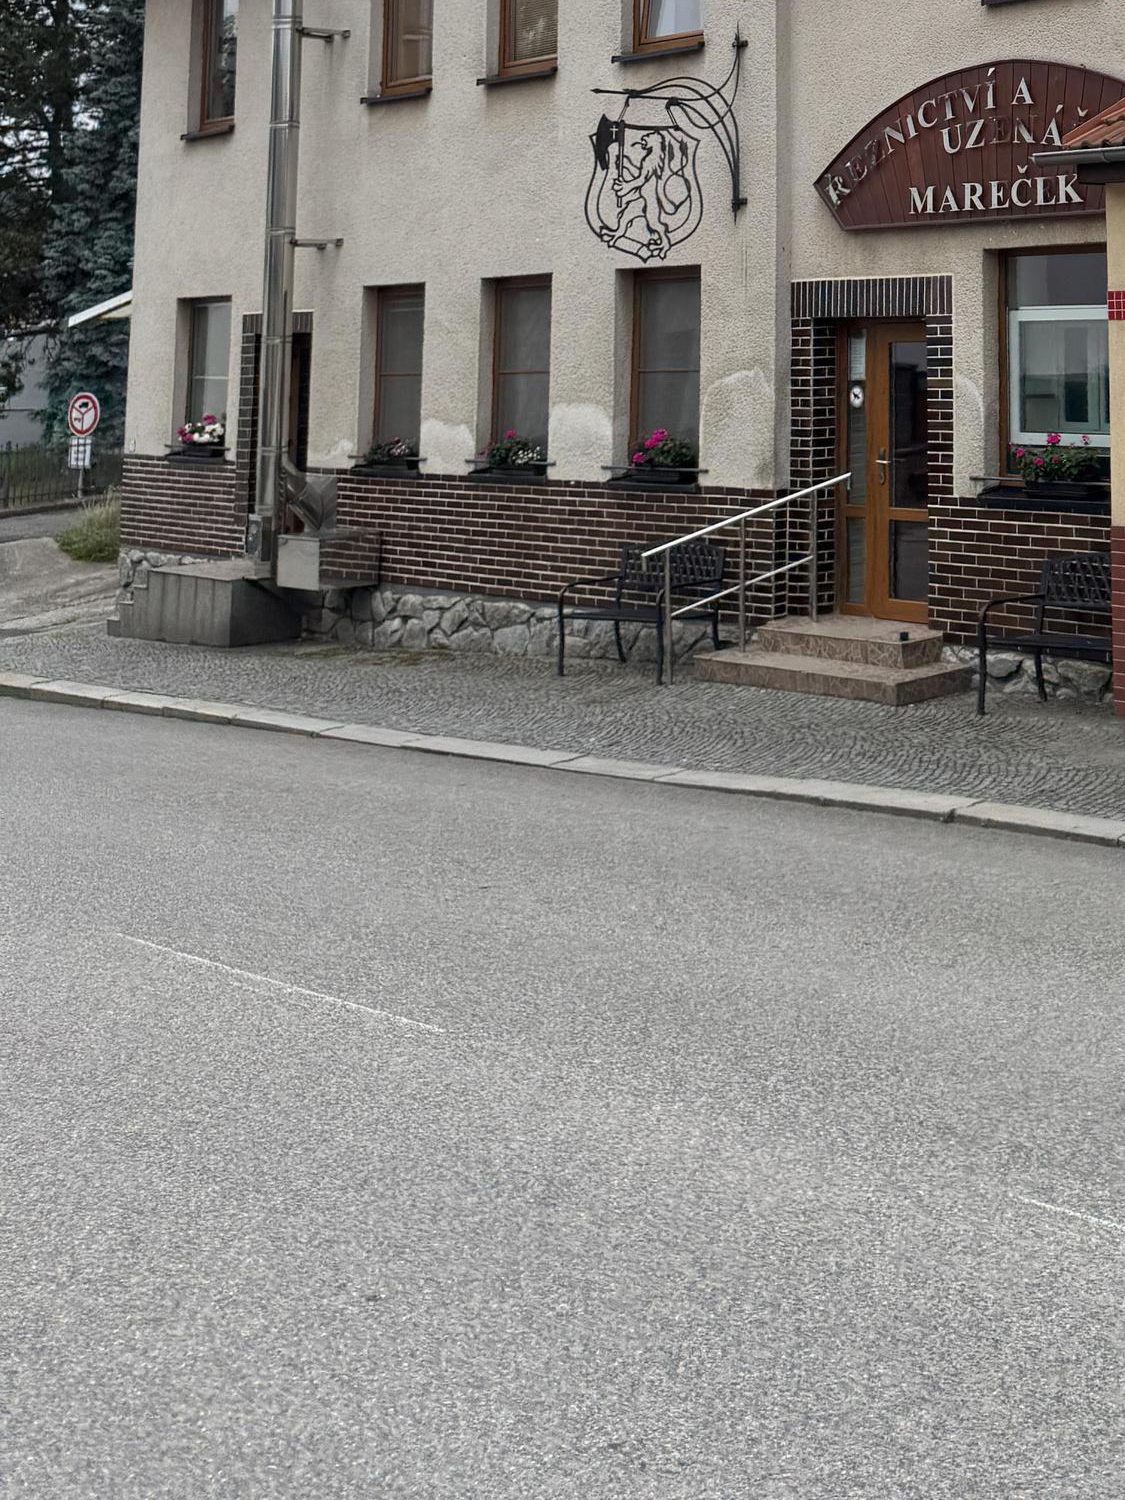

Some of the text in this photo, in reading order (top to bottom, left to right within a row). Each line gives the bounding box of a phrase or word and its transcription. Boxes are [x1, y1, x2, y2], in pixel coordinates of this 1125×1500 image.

[1010, 76, 1034, 106] A
[939, 104, 1089, 155] UZENÁ
[908, 164, 1084, 215] MAREČEK
